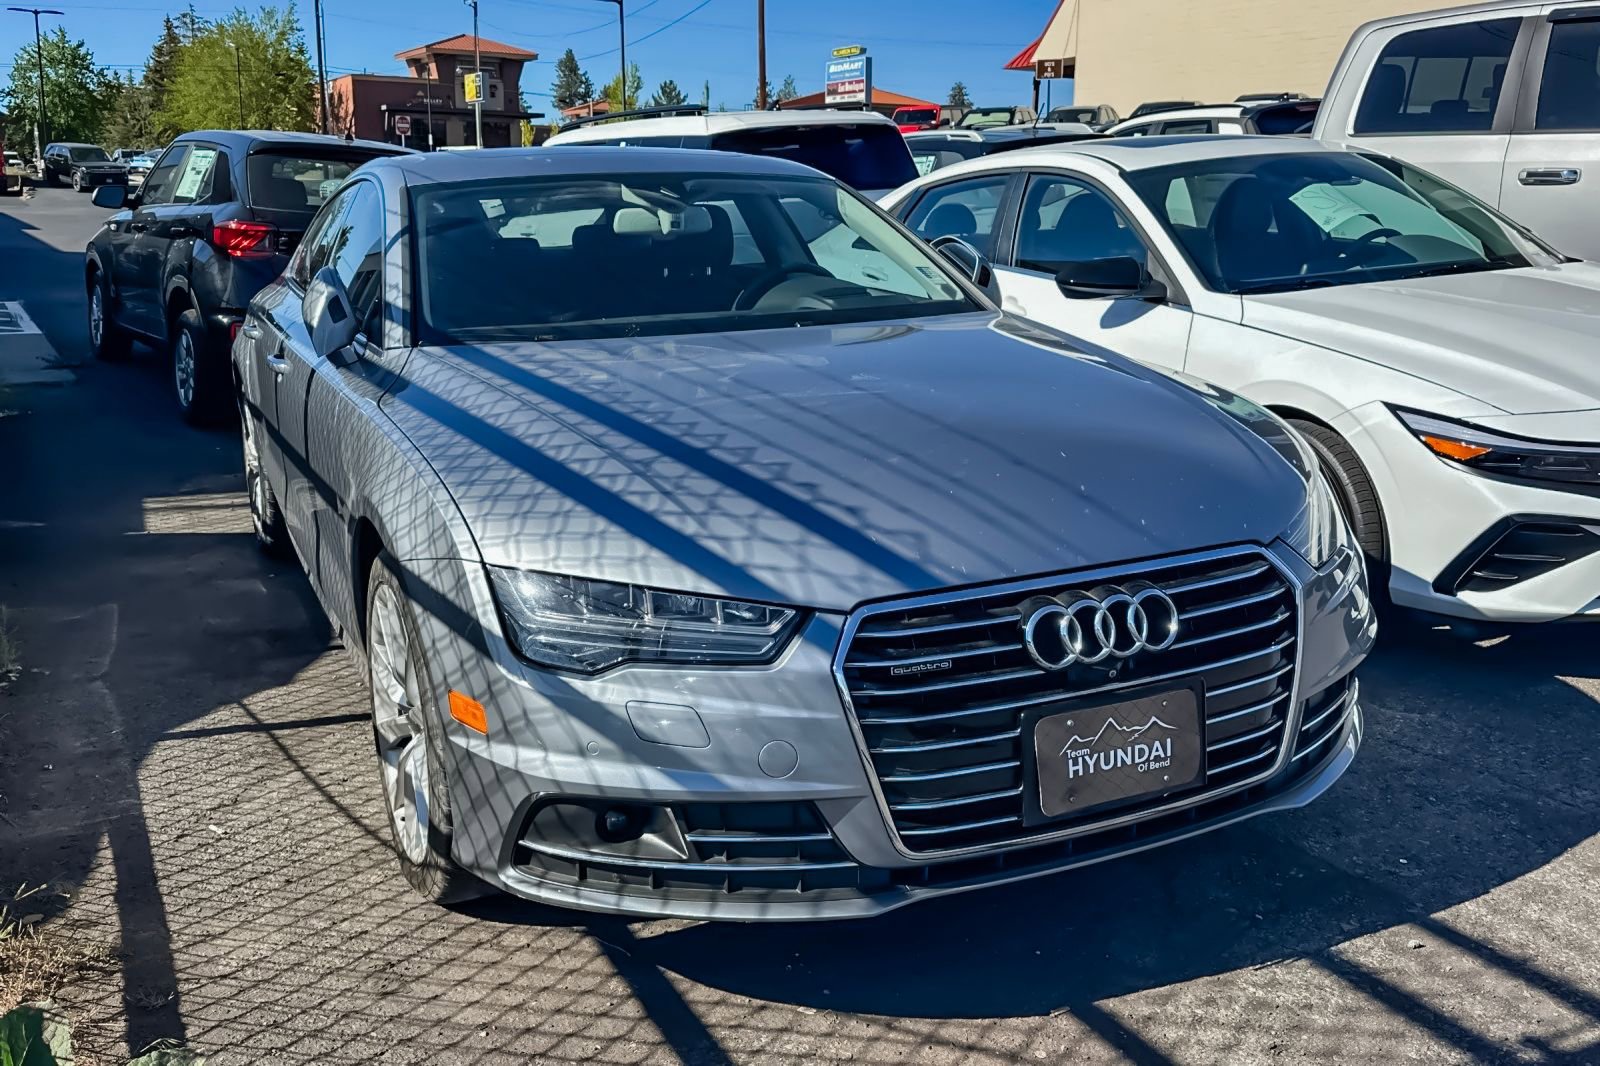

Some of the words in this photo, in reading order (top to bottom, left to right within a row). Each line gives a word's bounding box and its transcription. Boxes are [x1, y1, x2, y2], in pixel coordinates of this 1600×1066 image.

[894, 662, 949, 674] quattro
[1066, 747, 1090, 759] Team
[1068, 738, 1172, 778] HYUNDAI
[1137, 763, 1149, 773] Of
[1149, 758, 1170, 770] Bend
